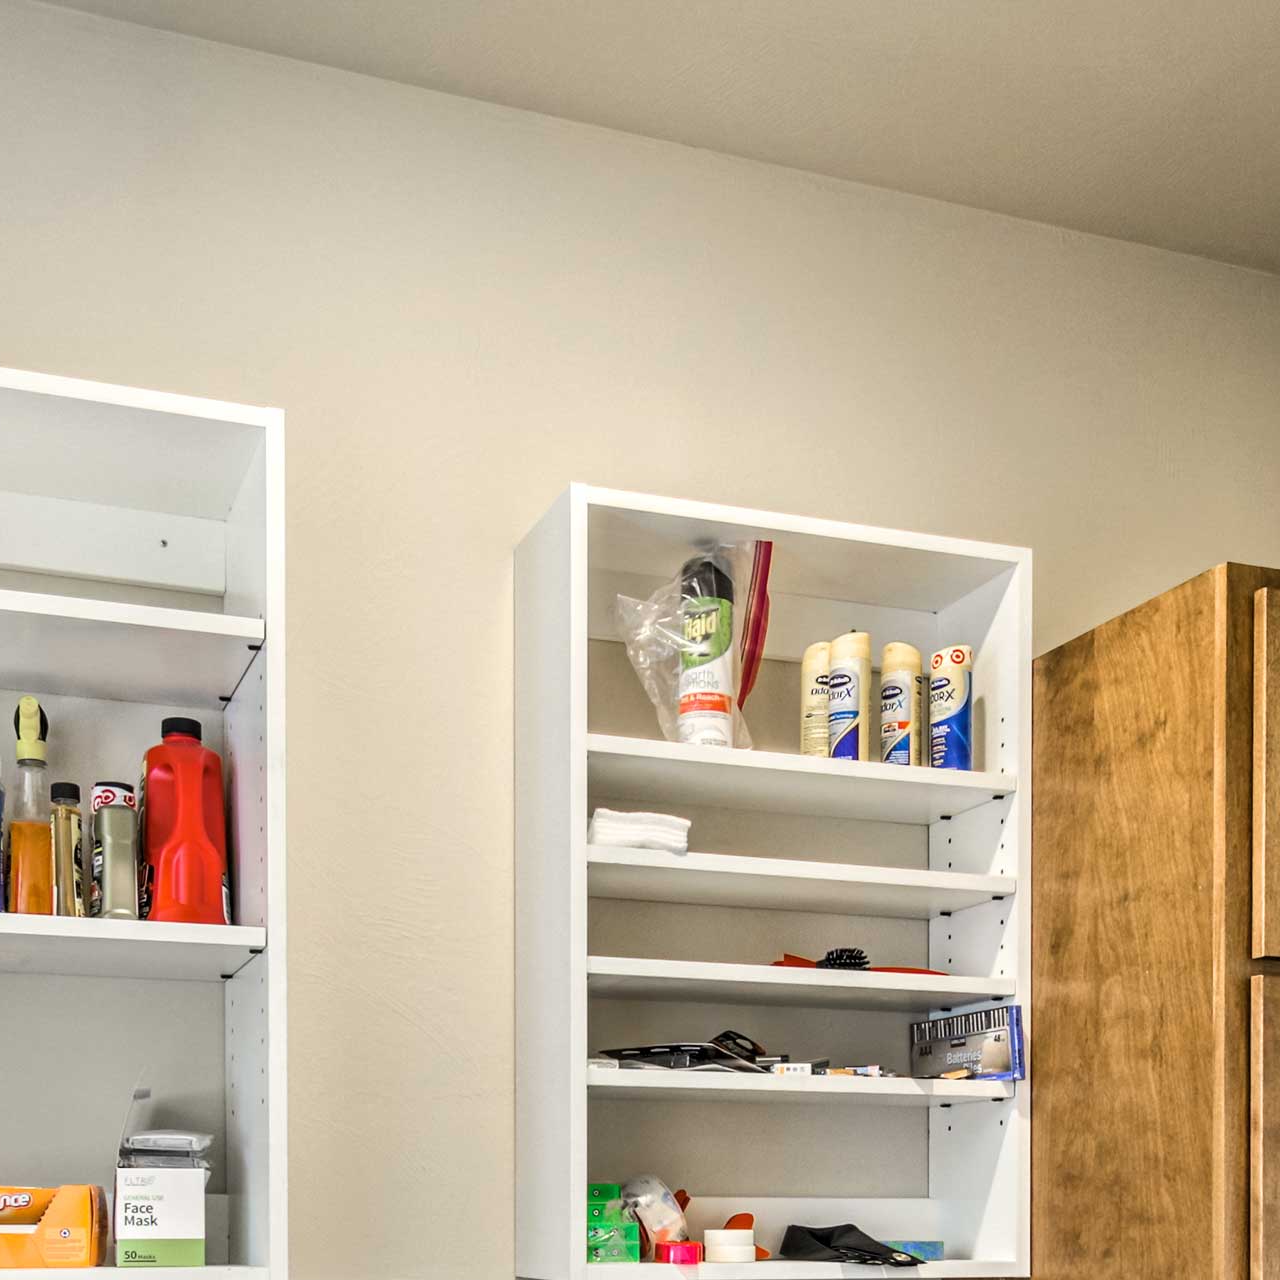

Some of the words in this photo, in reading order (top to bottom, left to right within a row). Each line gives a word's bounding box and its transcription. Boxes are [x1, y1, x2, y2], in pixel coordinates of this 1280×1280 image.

[946, 1049, 983, 1065] Batteries
[124, 1202, 154, 1214] Face
[124, 1214, 159, 1227] Mask
[124, 1250, 138, 1260] 50
